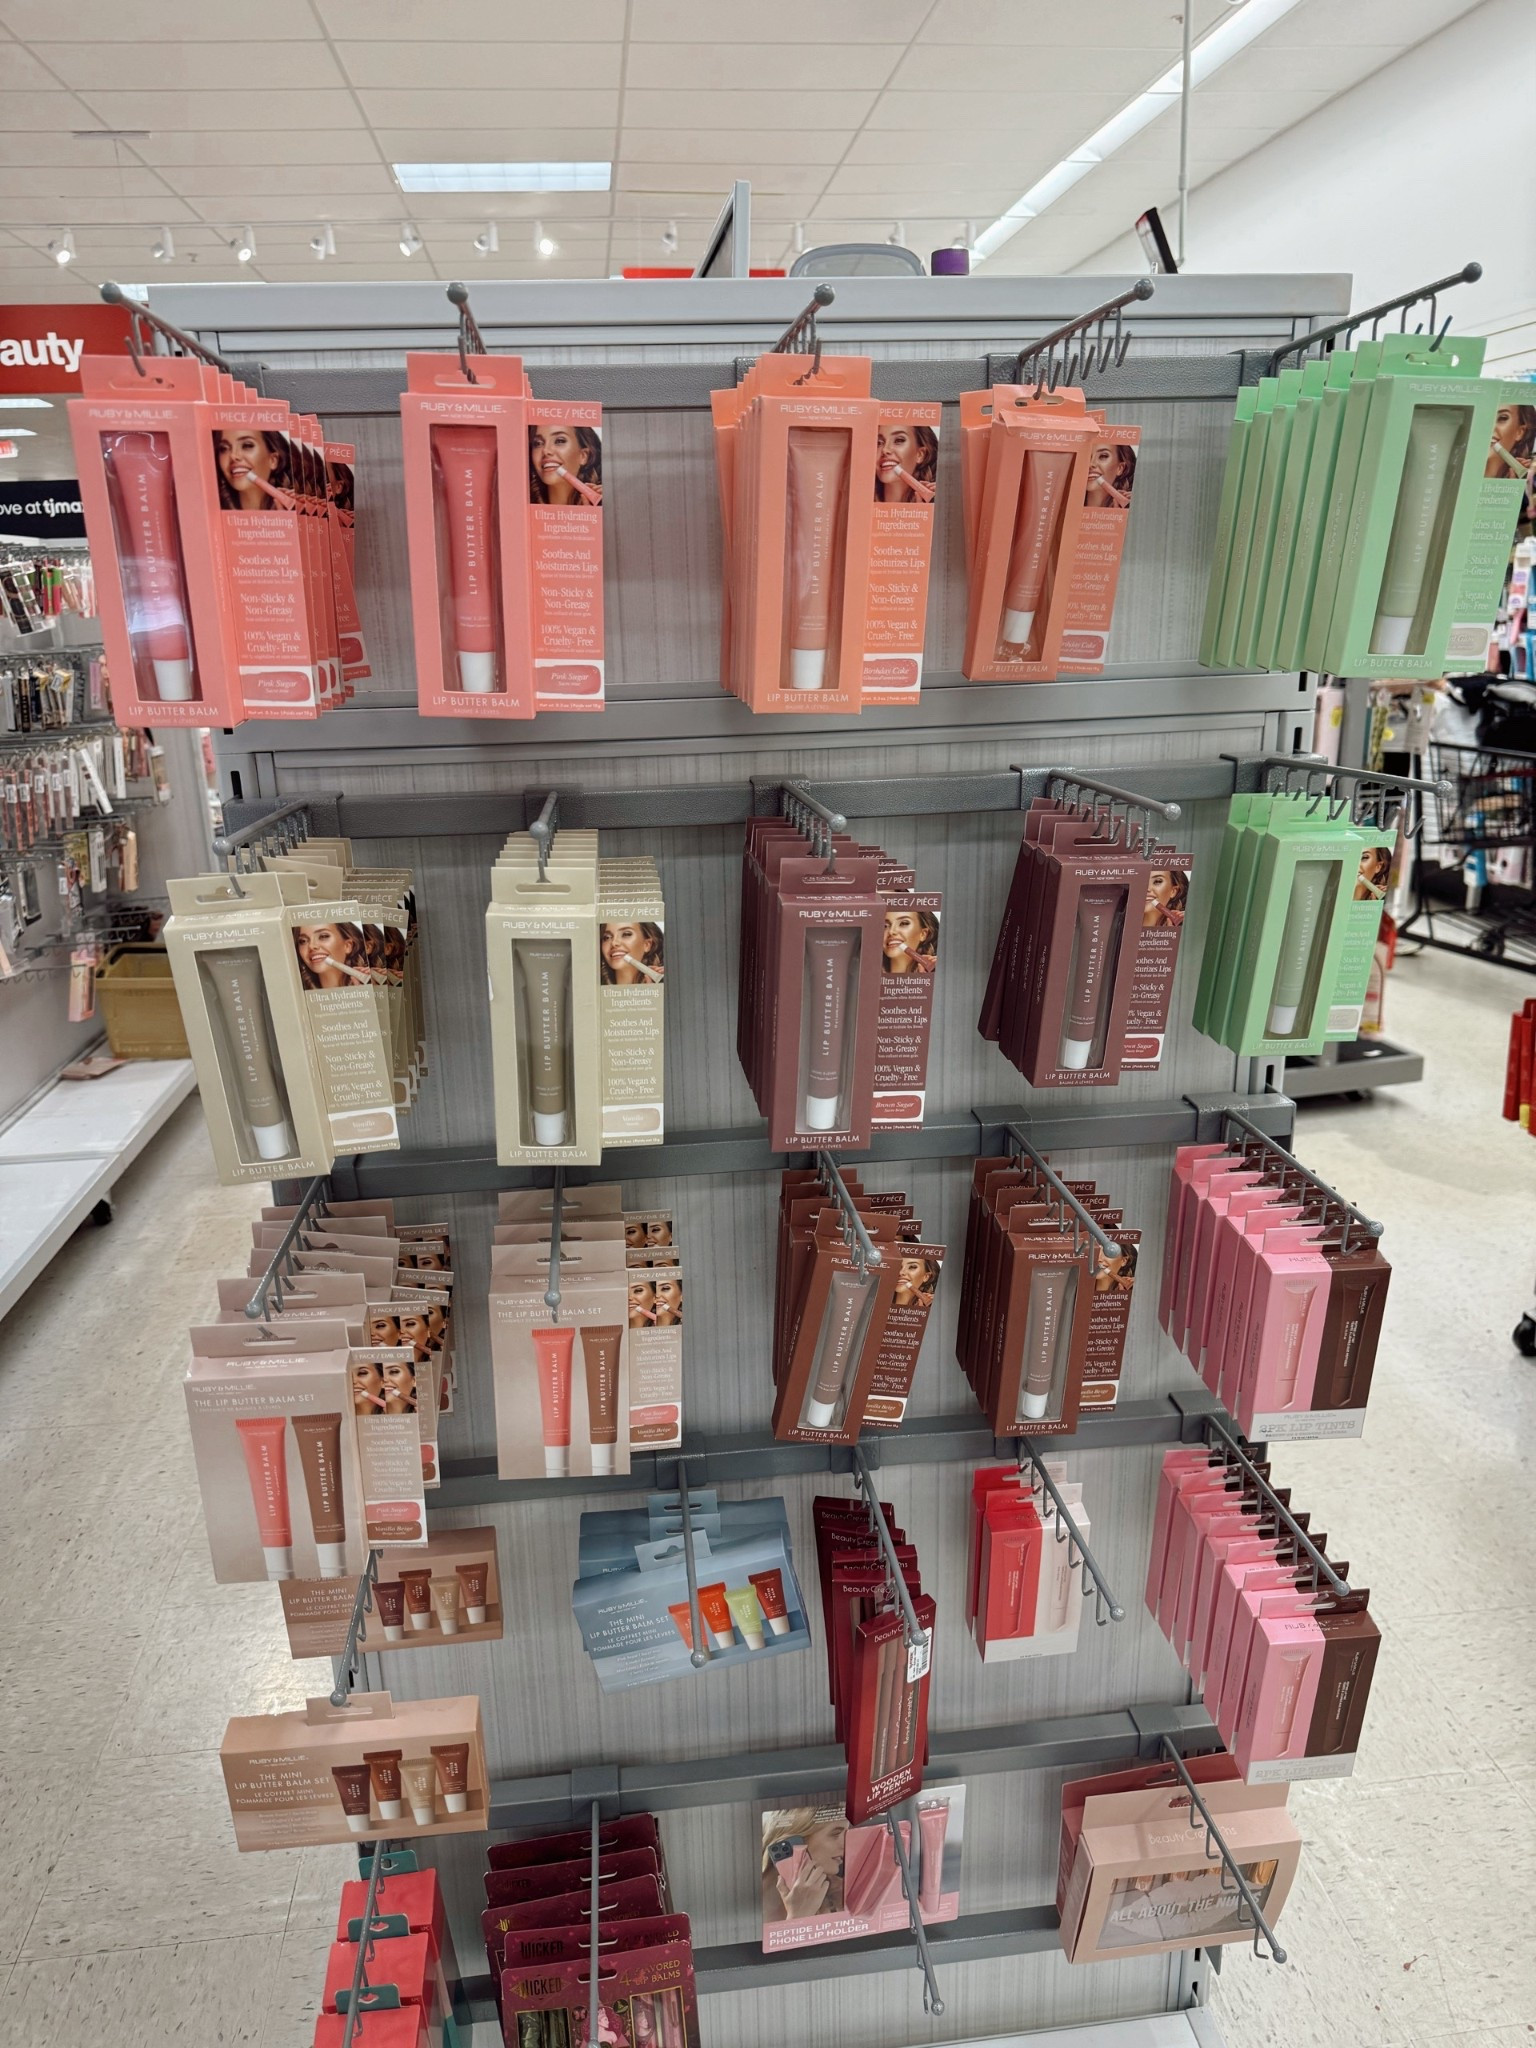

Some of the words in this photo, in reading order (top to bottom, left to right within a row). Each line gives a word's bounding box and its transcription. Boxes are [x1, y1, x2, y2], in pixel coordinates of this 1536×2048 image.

[421, 402, 502, 414] RUBY&MILLIE
[536, 408, 562, 418] PIECE
[572, 407, 597, 419] PIÈCE
[781, 405, 858, 415] RUBY&MILLIE
[880, 408, 904, 418] PIECE
[912, 408, 936, 419] PIÈCE
[1019, 432, 1083, 442] RUBY&MILLIE
[464, 469, 473, 507] BALM
[816, 471, 825, 510] BALM
[25, 502, 42, 514] at
[535, 510, 556, 521] Ultra
[557, 511, 597, 524] Hydrating
[544, 523, 589, 535] Ingredients
[466, 514, 476, 567] BUTTER
[813, 516, 823, 567] BUTTER
[542, 549, 573, 560] Soothes
[575, 549, 591, 560] And
[536, 561, 581, 572] Moisturizes
[582, 562, 599, 573] Lips
[469, 575, 477, 595] LIP
[811, 575, 819, 594] LIP
[541, 587, 585, 599] Non-Sticky
[545, 600, 591, 612] Non-Greasy
[541, 625, 562, 635] 100%
[564, 626, 587, 637] Vegan
[544, 636, 575, 648] Cruelty-
[577, 637, 594, 647] Free
[982, 664, 993, 673] LIP
[996, 664, 1023, 673] BUTTER
[1024, 664, 1048, 673] BALM
[1355, 659, 1367, 667] LIP
[1369, 659, 1405, 668] BUTTER
[1407, 660, 1433, 669] BALM
[569, 673, 589, 683] Sugar
[433, 697, 447, 705] LIP
[451, 697, 488, 707] BUTTER
[491, 698, 520, 707] BALM
[767, 694, 780, 702] LIP
[784, 694, 819, 702] BUTTER
[822, 694, 849, 702] BALM
[129, 707, 143, 716] LIP
[148, 707, 185, 716] BUTTER
[189, 708, 218, 716] BALM
[1170, 857, 1190, 866] PIÈCE
[1075, 868, 1135, 876] RUBY&MILLIE
[887, 898, 908, 906] PIECE
[916, 898, 938, 906] PIÈCE
[297, 909, 323, 920] PIECE
[331, 906, 355, 917] PIÈCE
[605, 909, 629, 917] PIECE
[638, 906, 660, 917] PIÈCE
[799, 910, 868, 918] RUBY&MILLIE
[503, 921, 576, 930] RUBY&MILLIE
[183, 927, 260, 943] RUBY&MILLIE
[1087, 948, 1097, 984] BUTTER
[826, 958, 834, 989] BALM
[897, 977, 930, 986] Hydrating
[884, 987, 923, 996] Ingredients
[824, 993, 833, 1035] BUTTER
[880, 1006, 908, 1016] Soothes
[909, 1006, 922, 1015] And
[876, 1035, 914, 1046] Non-Sticky
[878, 1044, 919, 1055] Non-Greasy
[893, 1065, 913, 1074] Vegan
[875, 1073, 902, 1083] Cruelty-
[1059, 1072, 1088, 1080] BUTTER
[786, 1136, 798, 1145] LIP
[800, 1136, 831, 1144] BUTTER
[834, 1135, 860, 1143] BALM
[526, 1151, 559, 1159] BUTTER
[232, 1167, 246, 1177] LIP
[249, 1163, 285, 1176] BUTTER
[288, 1161, 315, 1172] BALM
[1119, 1232, 1139, 1241] PIÈCE
[901, 1247, 918, 1256] PIECE
[926, 1247, 943, 1257] PIÈCE
[1043, 1316, 1051, 1347] BUTTER
[195, 1400, 211, 1408] THE
[215, 1399, 230, 1407] LIP
[232, 1397, 265, 1406] BUTTER
[269, 1396, 296, 1404] BALM
[299, 1394, 315, 1402] SET
[1290, 1423, 1313, 1432] LIP
[1315, 1421, 1356, 1430] TINTS
[788, 1429, 799, 1437] LIP
[801, 1431, 828, 1440] BUTTER
[829, 1432, 850, 1440] BALM
[626, 1614, 645, 1623] MINI
[589, 1631, 600, 1639] LIP
[603, 1625, 631, 1636] BUTTER
[633, 1621, 654, 1630] BALM
[250, 1781, 283, 1789] BUTTER
[287, 1778, 312, 1787] BALM
[872, 1768, 911, 1793] WOODEN
[867, 1791, 880, 1803] LIP
[883, 1774, 914, 1794] PENCIL
[1112, 1908, 1135, 1922] ALL
[1138, 1904, 1183, 1919] ABOUT
[1189, 1897, 1215, 1911] THE
[770, 1925, 813, 1939] PEPTIDE
[815, 1922, 832, 1932] LIP
[835, 1919, 855, 1928] TINT
[770, 1936, 806, 1947] PHONE
[809, 1931, 825, 1941] LIP
[827, 1924, 869, 1938] HOLDER
[651, 1969, 681, 1983] BALMS
[521, 1978, 562, 1999] WICKED
